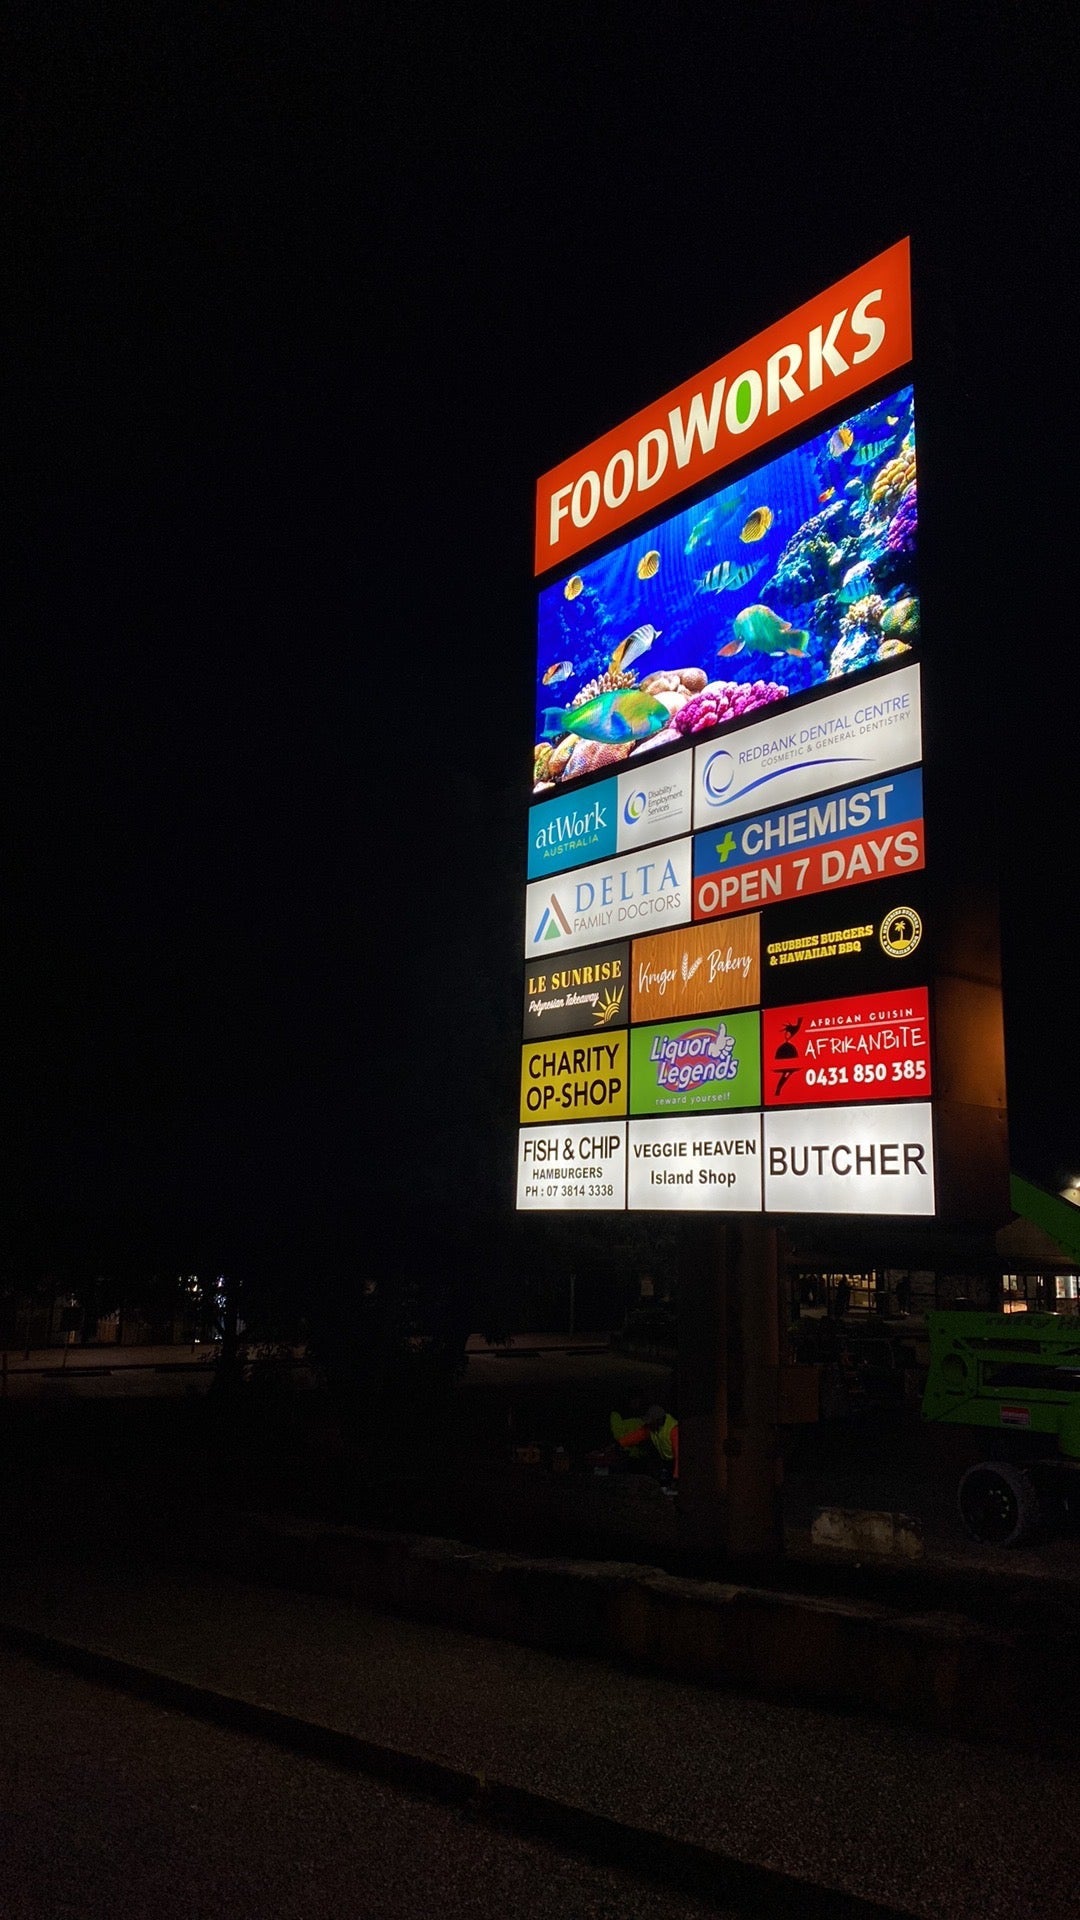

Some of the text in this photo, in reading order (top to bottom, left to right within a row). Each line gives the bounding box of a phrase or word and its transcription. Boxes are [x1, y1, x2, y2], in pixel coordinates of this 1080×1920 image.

[549, 288, 886, 546] FOODWORKS
[738, 693, 910, 765] REDBANK DENTAL CENTRE
[761, 710, 912, 768] COSMETIC & GENERAL DENTISTRY
[648, 785, 673, 800] Disability
[648, 790, 683, 808] Employment
[648, 804, 670, 817] Services
[741, 784, 894, 856] CHEMIST
[535, 802, 608, 849] atWork
[543, 834, 600, 859] AUSTRALIA
[575, 858, 681, 913] DELTA
[698, 831, 920, 913] OPEN 7 DAYS
[573, 893, 681, 932] FAMILY DOCTORS
[767, 934, 820, 954] GRUBBIES
[820, 924, 874, 945] BURGERS
[769, 940, 862, 966] & HAWAIIAN BBQ
[528, 960, 622, 995] LE SUNRISE
[638, 946, 753, 996] Kruger Bakery
[528, 992, 600, 1017] Polynesian Takeaway
[810, 1008, 913, 1028] AFRICAN CUISIN
[528, 1043, 621, 1080] CHARITY
[650, 1035, 711, 1064] Liquor
[657, 1053, 738, 1089] Legends
[805, 1060, 926, 1086] 0431 850 385
[526, 1078, 622, 1112] OP-SHOP
[656, 1092, 731, 1106] reward yourself
[523, 1135, 621, 1162] FISH & CHIP
[633, 1139, 757, 1158] VEGGIE HEAVEN
[769, 1142, 928, 1177] BUTCHER
[532, 1167, 604, 1180] HAMBURGERS
[650, 1168, 737, 1188] Island Shop
[525, 1186, 538, 1197] PH
[546, 1185, 559, 1197] 07
[561, 1184, 586, 1197] 3814
[588, 1184, 614, 1197] 3338
